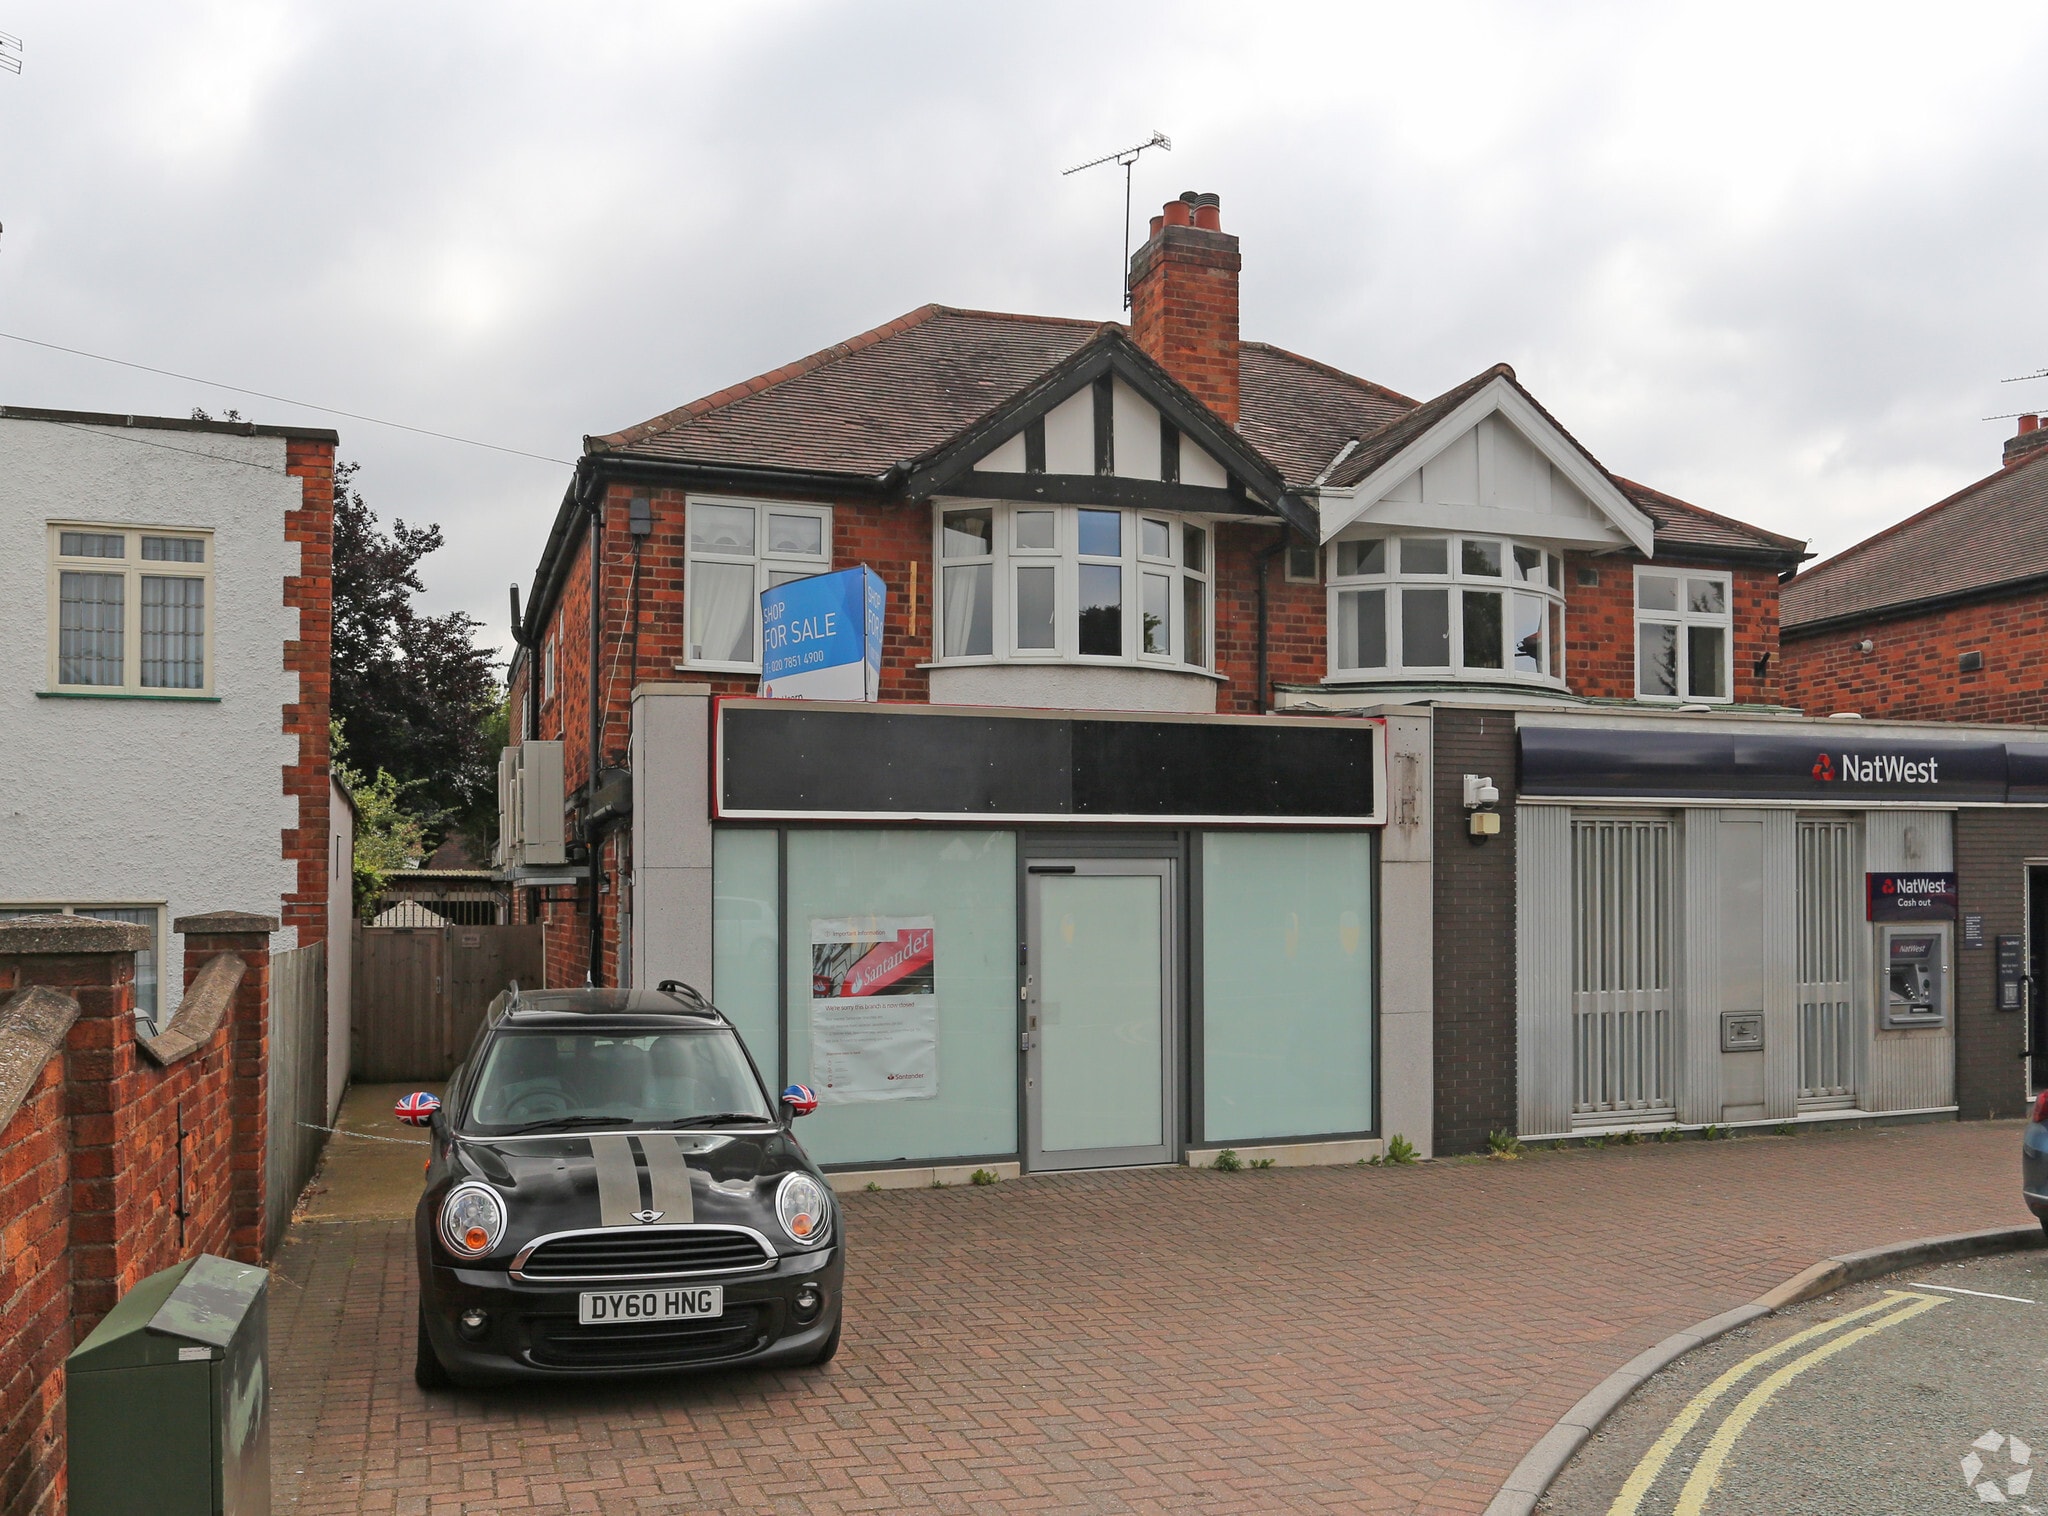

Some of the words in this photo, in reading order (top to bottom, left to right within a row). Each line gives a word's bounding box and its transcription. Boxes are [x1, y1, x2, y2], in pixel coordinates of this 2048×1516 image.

[868, 586, 880, 609] SHOP
[764, 602, 785, 624] SHOP
[764, 624, 788, 651] FOR
[791, 612, 837, 643] SALE
[784, 655, 801, 669] 7851
[803, 650, 824, 664] 4900
[1842, 754, 1938, 784] NatWest
[1897, 878, 1946, 894] NatWest
[1897, 898, 1916, 907] Cash
[1918, 898, 1931, 906] out
[863, 930, 931, 986] Santander
[1898, 945, 1926, 953] NatWest
[841, 1004, 854, 1012] sorry
[591, 1293, 657, 1319] DY60
[664, 1290, 712, 1315] HNG
